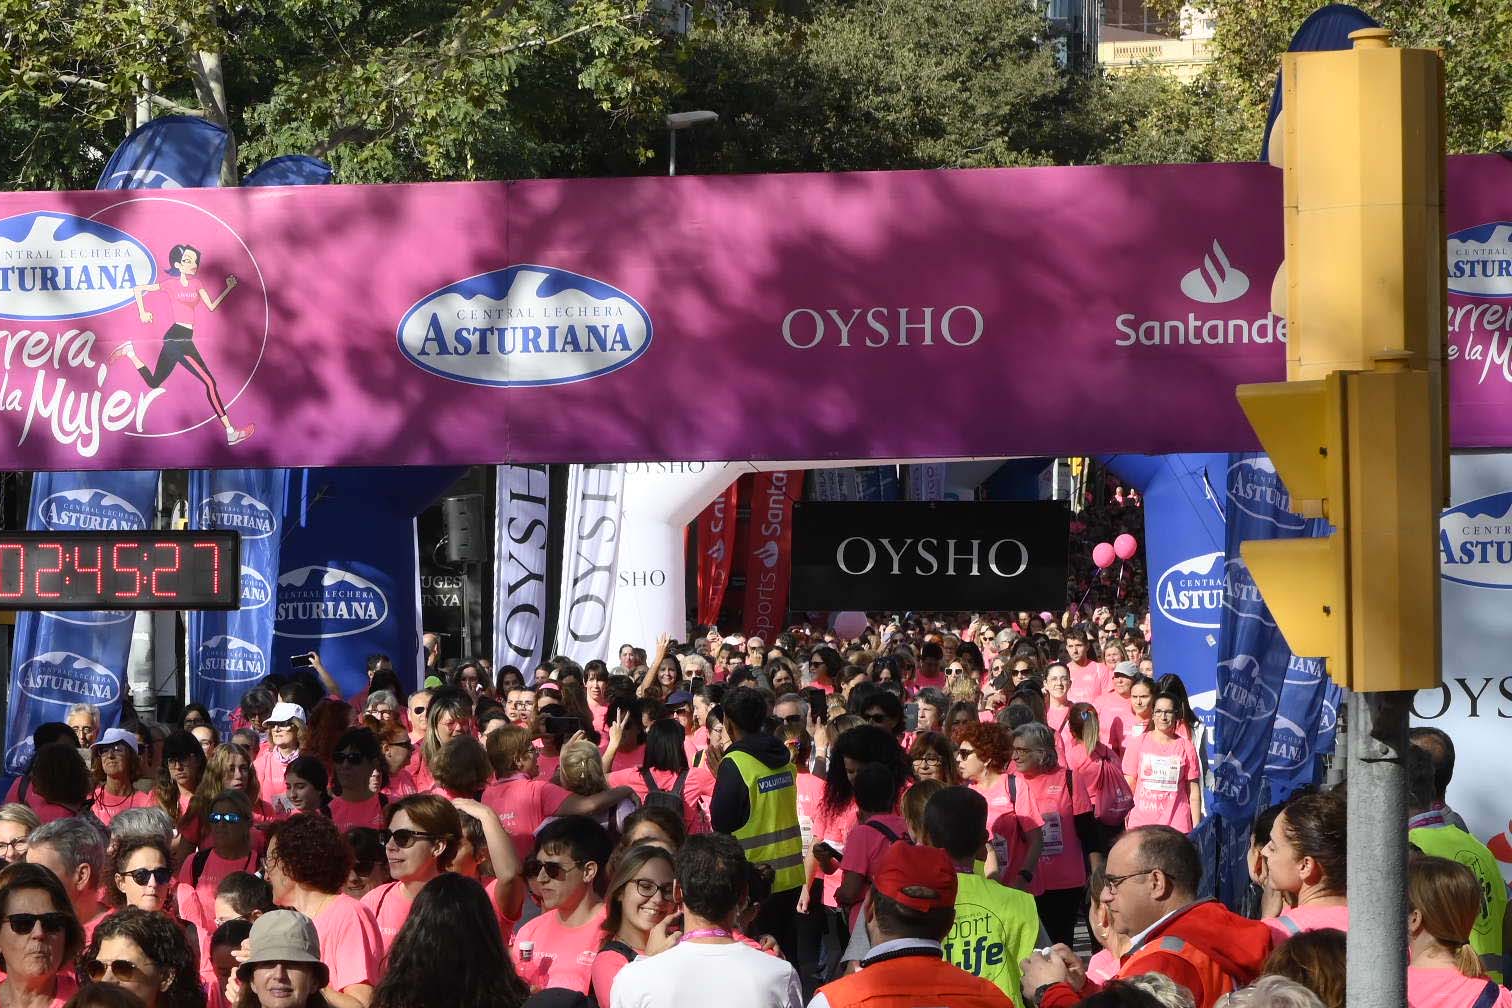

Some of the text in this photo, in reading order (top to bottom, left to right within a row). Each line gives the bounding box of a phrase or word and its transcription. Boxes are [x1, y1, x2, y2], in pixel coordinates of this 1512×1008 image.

[60, 248, 131, 259] LECHERA
[456, 306, 624, 320] CENTRAL LECHERA
[782, 305, 985, 348] OYSHO
[417, 312, 633, 356] ASTURIANA
[1114, 312, 1288, 347] Santande
[1465, 334, 1483, 360] la
[18, 363, 166, 458] Mujer
[761, 471, 788, 536] Santa
[1462, 526, 1512, 536] CENTR
[504, 464, 548, 658] OYSH
[568, 464, 619, 643] OYSH
[836, 536, 1029, 578] OYSHO
[422, 575, 462, 588] UGES
[619, 569, 666, 587] SHO
[1179, 579, 1223, 587] CENTRA
[325, 590, 374, 599] LECHERA
[274, 601, 378, 620] STURIANA
[24, 667, 112, 699] ASTURIANA
[947, 913, 992, 940] port
